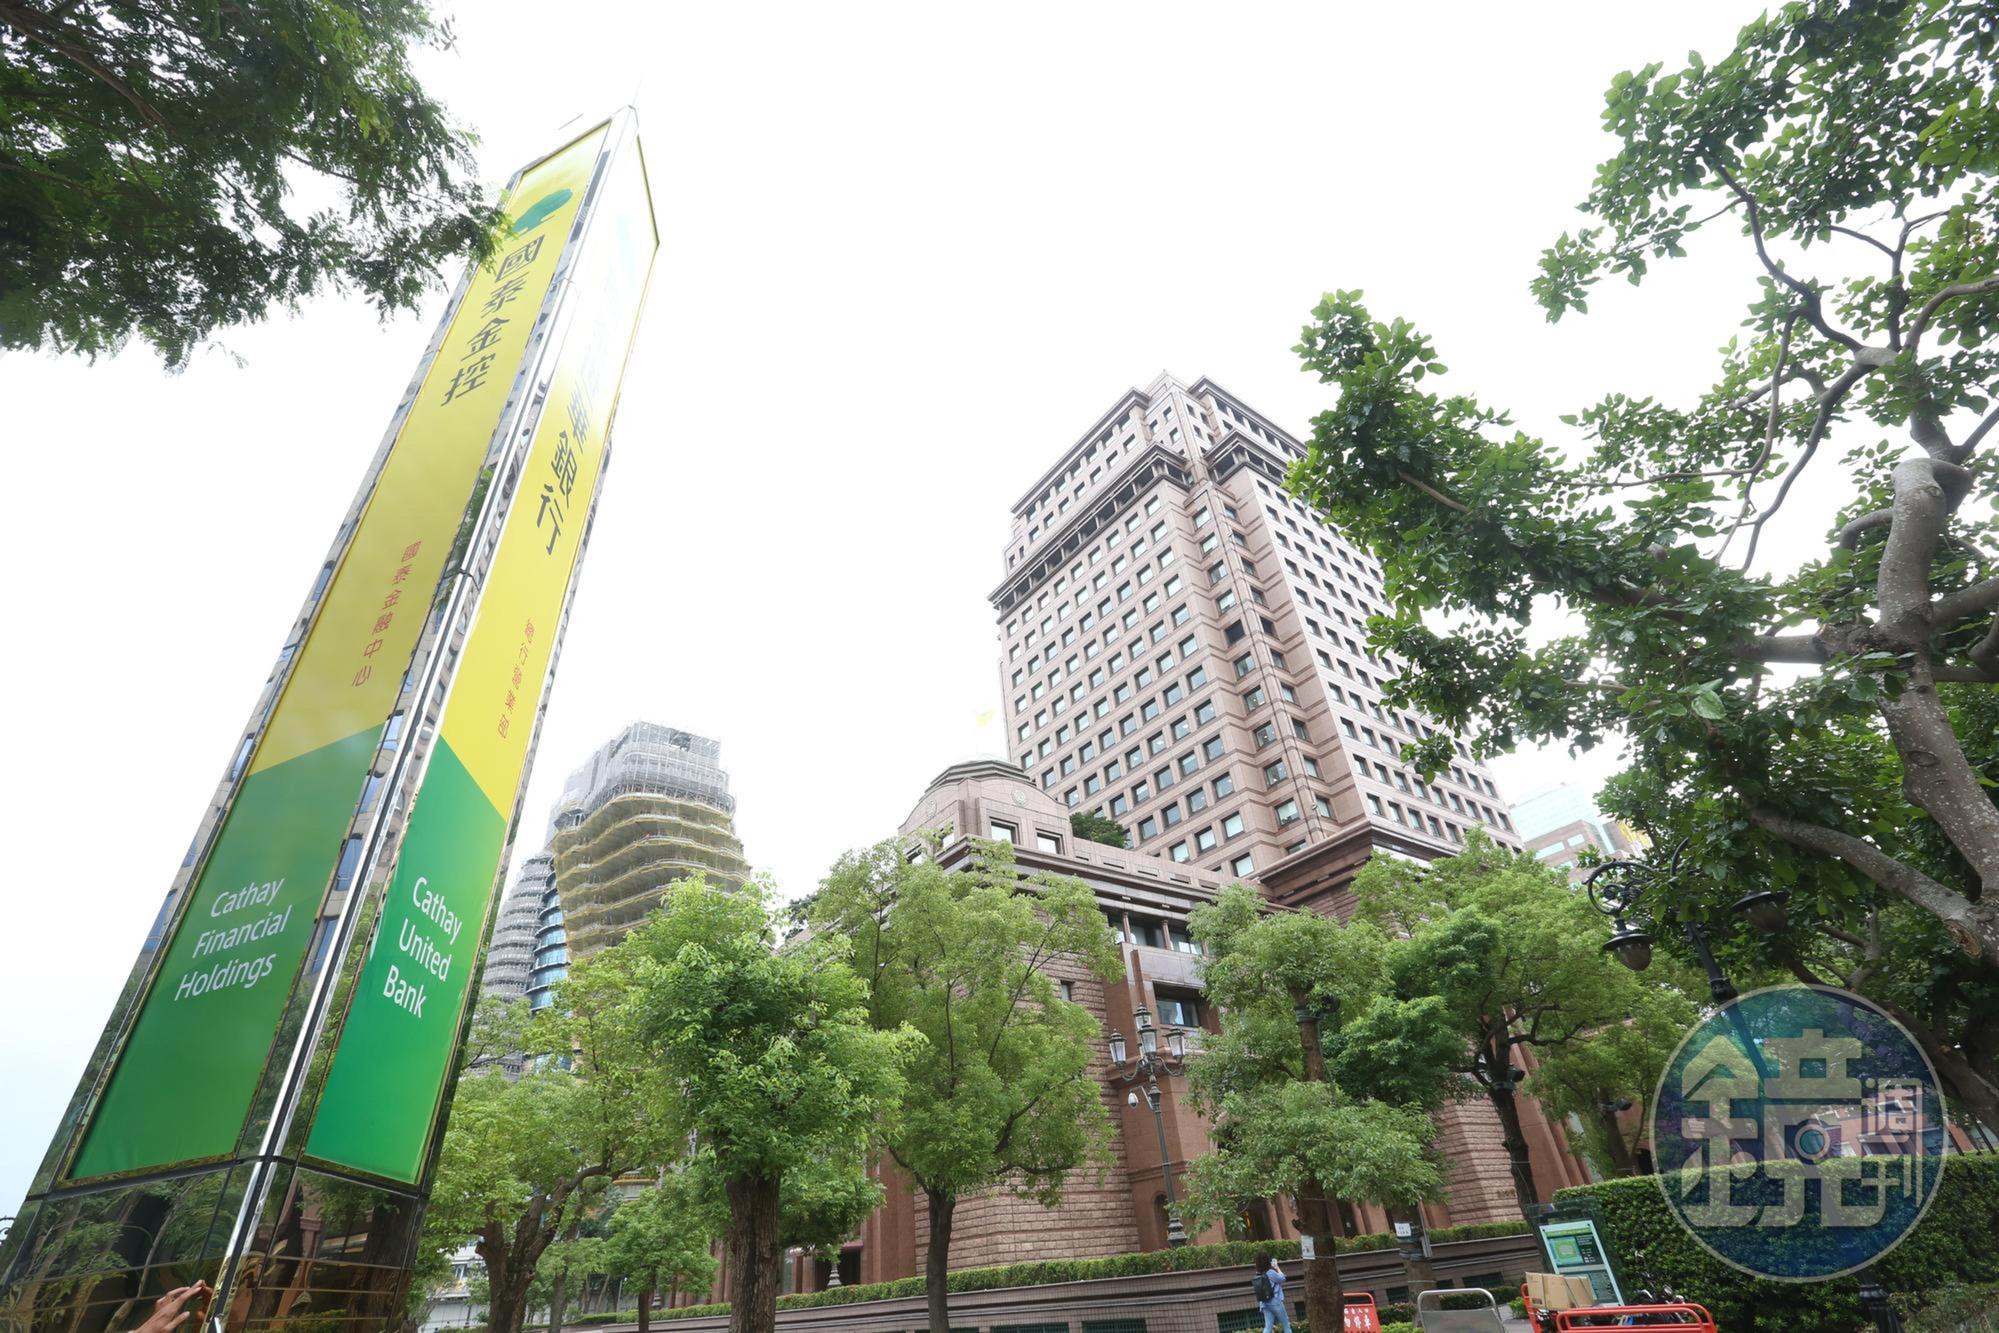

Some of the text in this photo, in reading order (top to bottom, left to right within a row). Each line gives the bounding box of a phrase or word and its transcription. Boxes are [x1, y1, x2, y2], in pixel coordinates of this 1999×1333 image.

[441, 234, 545, 407] 國泰金控
[210, 878, 285, 918] Cathay
[412, 877, 462, 945] Cathay
[192, 904, 293, 959] Financial
[399, 918, 452, 982] United
[174, 953, 277, 1001] Holdings
[383, 964, 427, 1018] Bank
